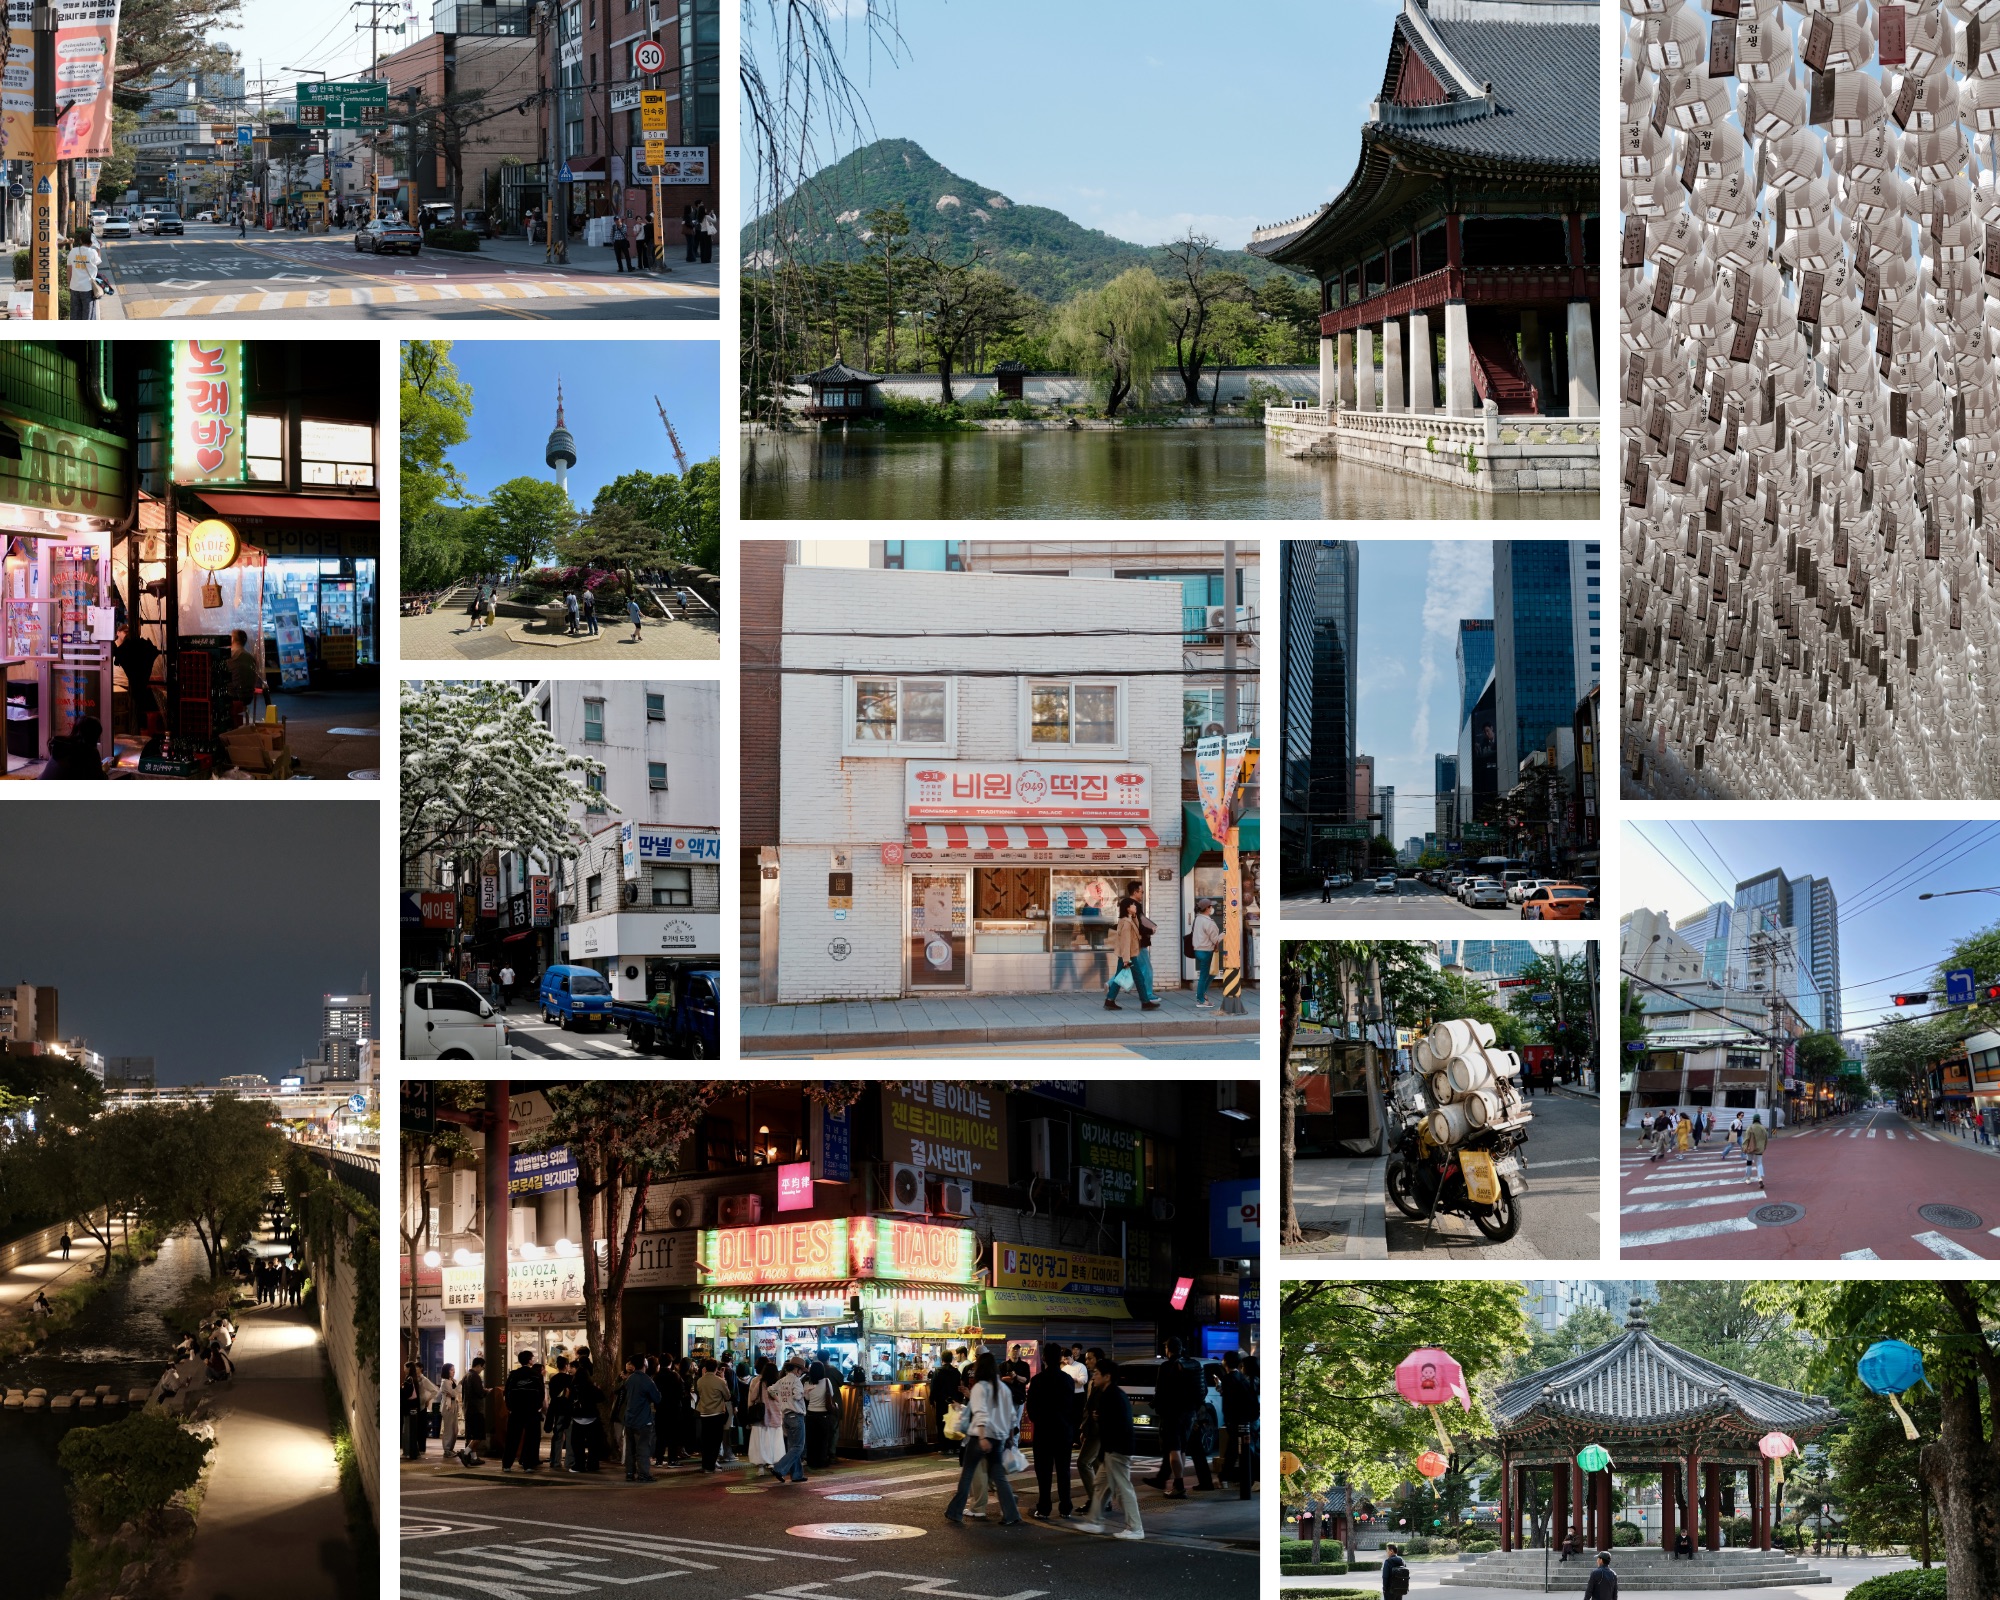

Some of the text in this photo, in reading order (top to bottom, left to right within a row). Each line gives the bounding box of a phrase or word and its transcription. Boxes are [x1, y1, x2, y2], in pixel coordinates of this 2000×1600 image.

[642, 51, 659, 64] 30
[643, 107, 664, 115] 단속중
[39, 206, 50, 295] 어린이 보호구역
[194, 541, 230, 552] OLDIES
[203, 554, 223, 562] TACO
[953, 773, 1012, 800] 비원
[1019, 780, 1044, 791] 1949
[1051, 774, 1108, 800] 떡집
[639, 836, 720, 860] 판넬 액자
[421, 902, 454, 920] 에이원
[1950, 992, 1974, 1001] 비보호
[933, 1082, 990, 1119] 몰아내는
[892, 1101, 999, 1151] 젠트리피케이션
[781, 1176, 811, 1190] 平均律
[716, 1222, 965, 1270] OLDIES TACO
[522, 1263, 558, 1278] GYOZA
[1019, 1251, 1068, 1278] 진영광고
[717, 1266, 830, 1282] VARIOUS TACOS DRINKS
[532, 1278, 558, 1289] ギョーザ
[1028, 1281, 1059, 1290] 2267-0188
[510, 1292, 524, 1301] 우동
[536, 1311, 555, 1322] うどん
